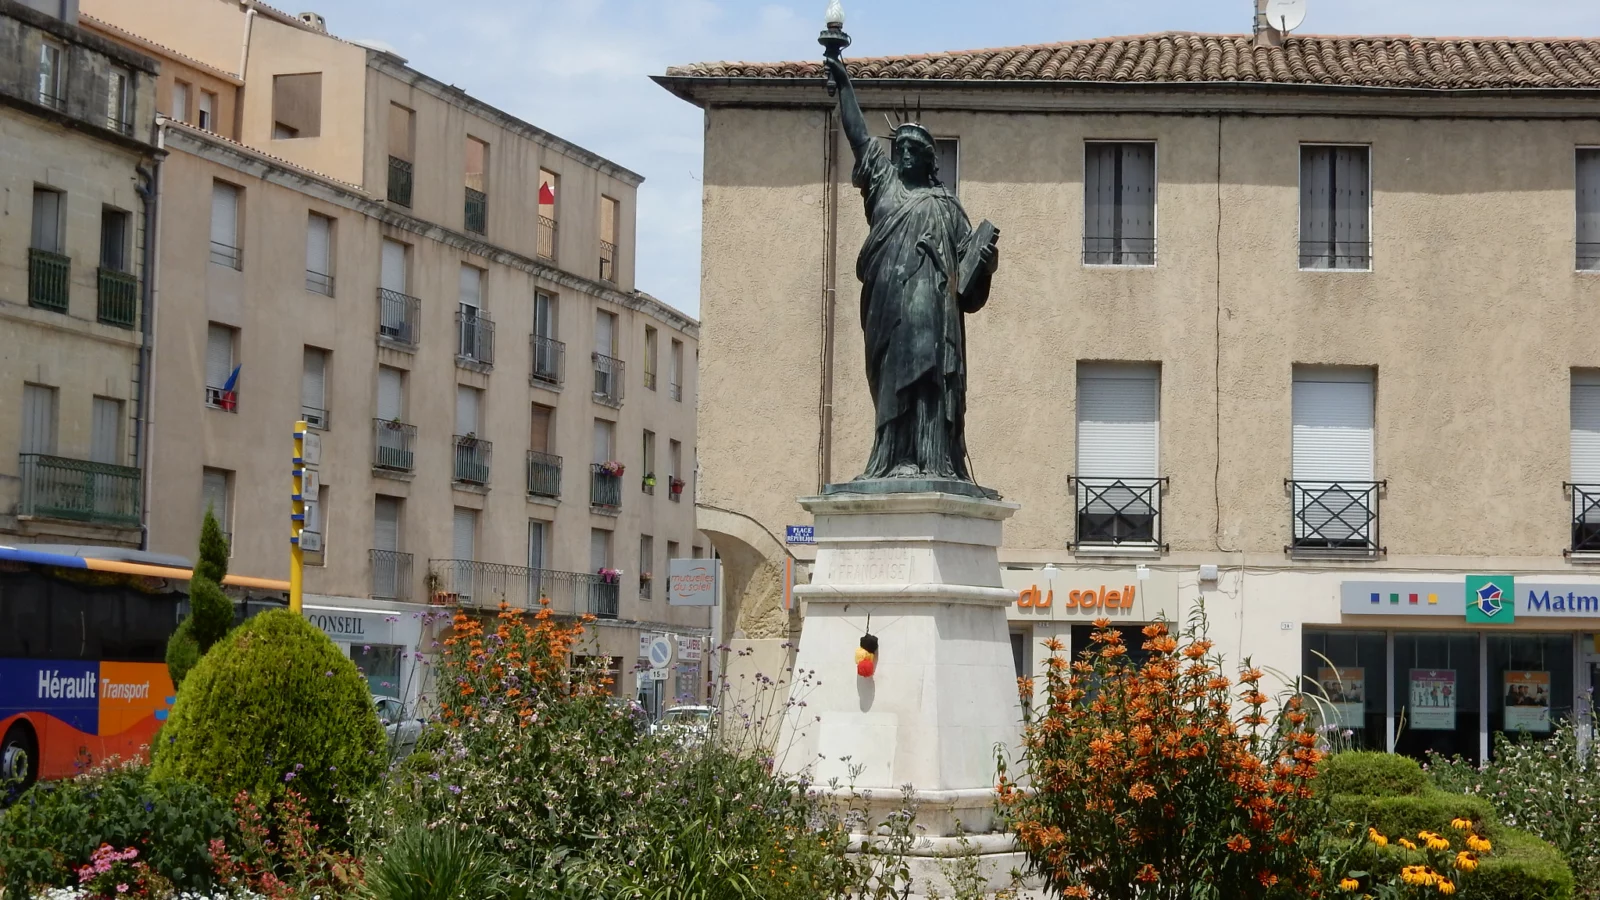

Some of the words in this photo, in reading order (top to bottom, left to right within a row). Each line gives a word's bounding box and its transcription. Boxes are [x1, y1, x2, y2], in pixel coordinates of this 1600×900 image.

[671, 574, 714, 582] mutuelles
[673, 583, 686, 591] du
[688, 583, 711, 591] soleil
[1017, 584, 1053, 608] du
[1066, 585, 1136, 608] soleil
[1528, 590, 1599, 611] Matm
[308, 614, 365, 634] CONSEIL
[38, 670, 96, 699] Hérault
[102, 678, 150, 703] Transport
